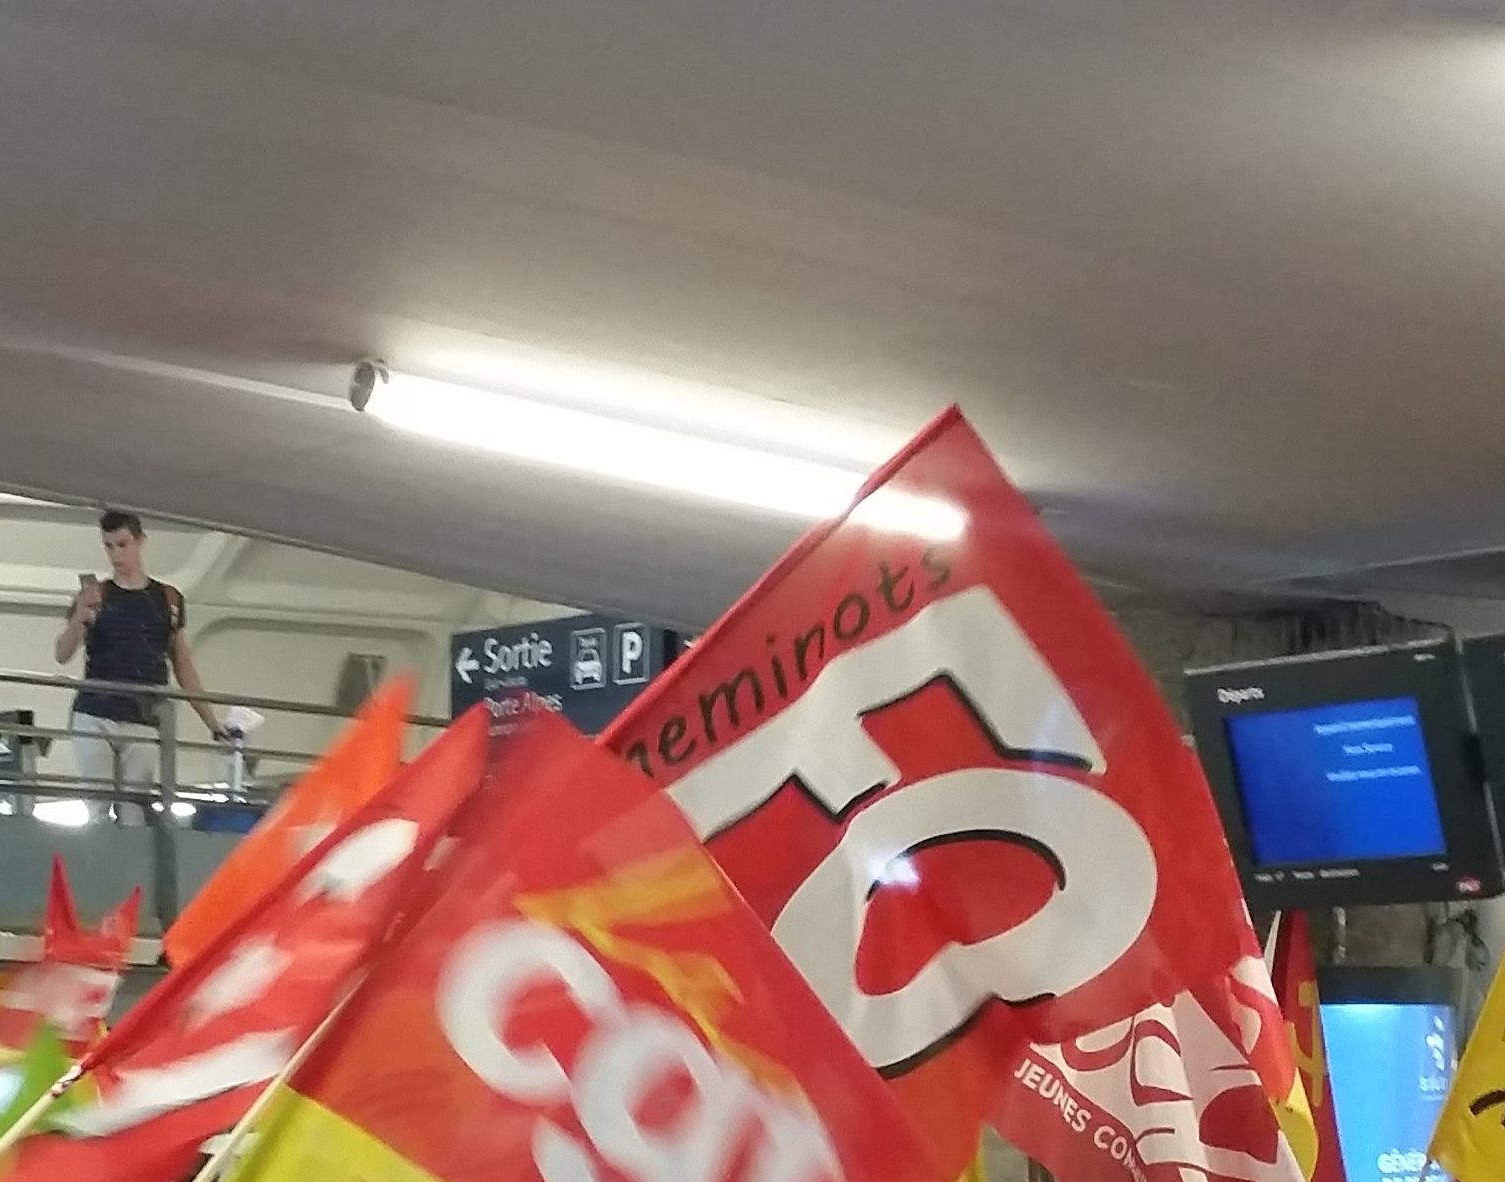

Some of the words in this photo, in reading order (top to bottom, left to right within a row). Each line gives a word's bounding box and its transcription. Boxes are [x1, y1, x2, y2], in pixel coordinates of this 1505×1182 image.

[483, 631, 554, 675] Sortie
[621, 631, 643, 675] P
[625, 543, 953, 778] eminots
[1013, 1058, 1092, 1133] JEUNES
